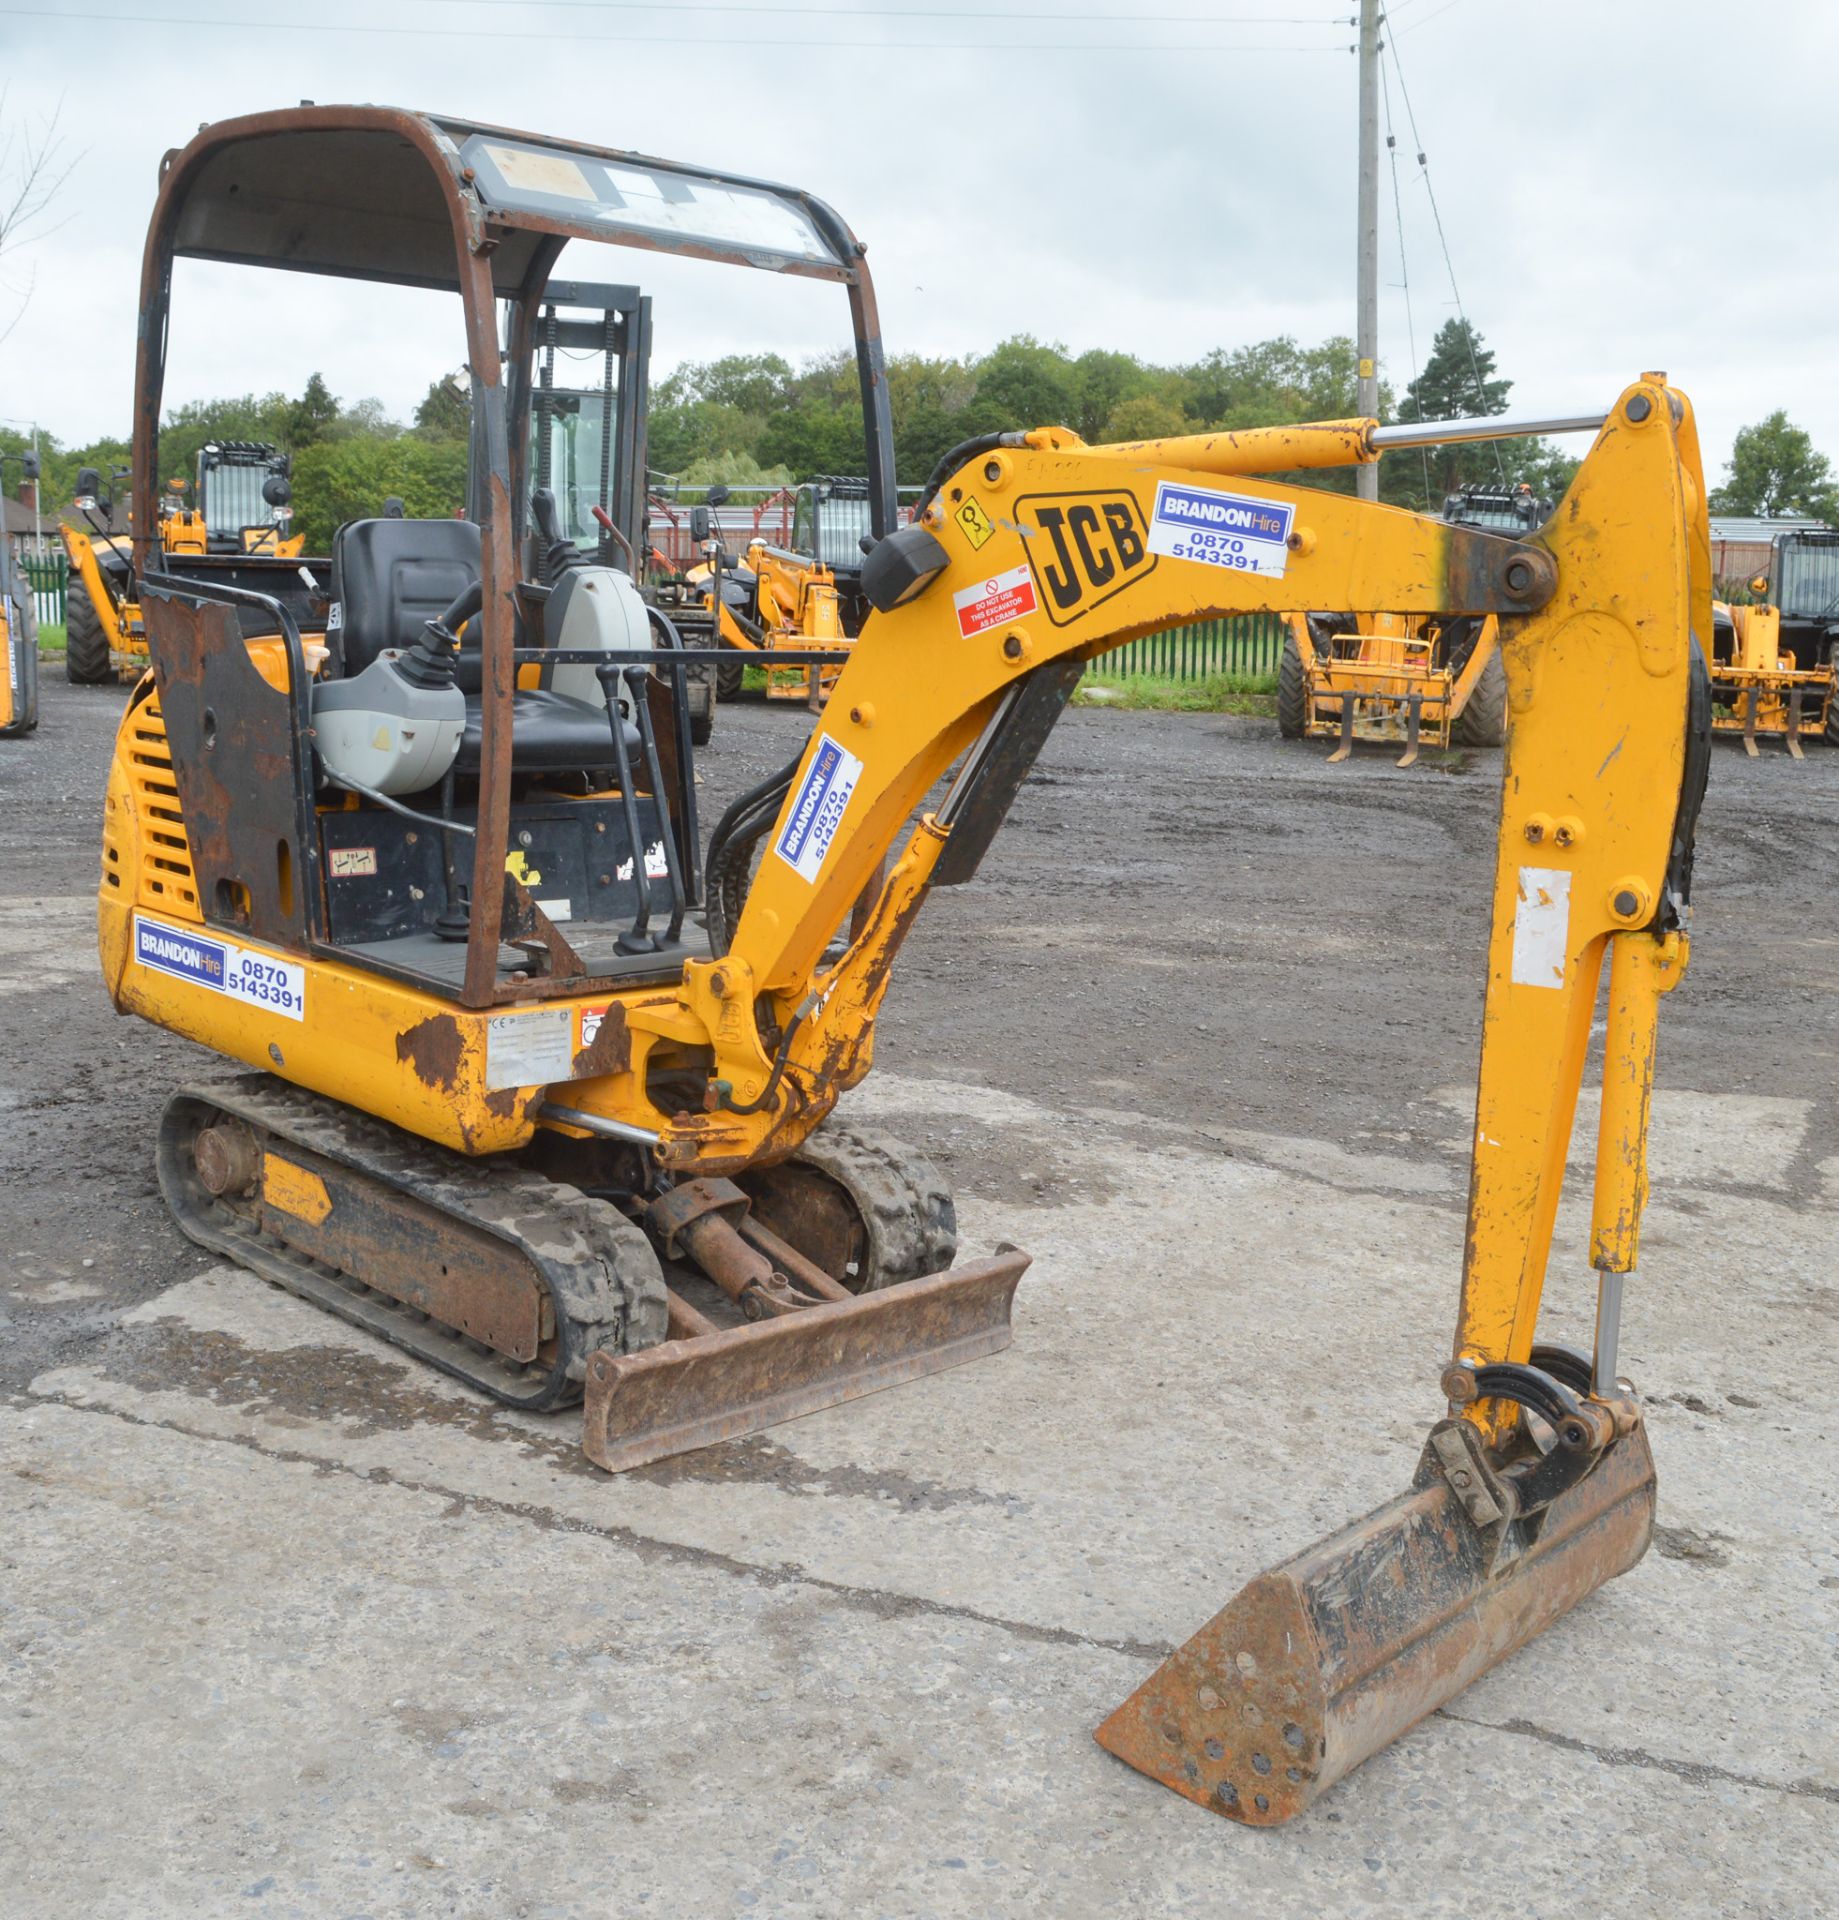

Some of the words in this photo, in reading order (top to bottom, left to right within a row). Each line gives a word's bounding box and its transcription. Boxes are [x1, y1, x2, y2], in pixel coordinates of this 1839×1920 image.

[1034, 503, 1145, 609] JCB
[1190, 532, 1244, 553] 0870
[1172, 544, 1259, 571] 5143391
[971, 612, 985, 622] THIS
[986, 597, 1023, 616] EXCAVATOR
[975, 603, 986, 611] DO
[986, 597, 1000, 606] NOT
[1000, 591, 1014, 601] USE
[980, 619, 989, 628] AS
[995, 608, 1018, 621] CRANE
[813, 790, 838, 839] 0870
[815, 781, 853, 861] 5143391
[241, 958, 288, 988] 0870
[228, 973, 302, 1011] 5143391
